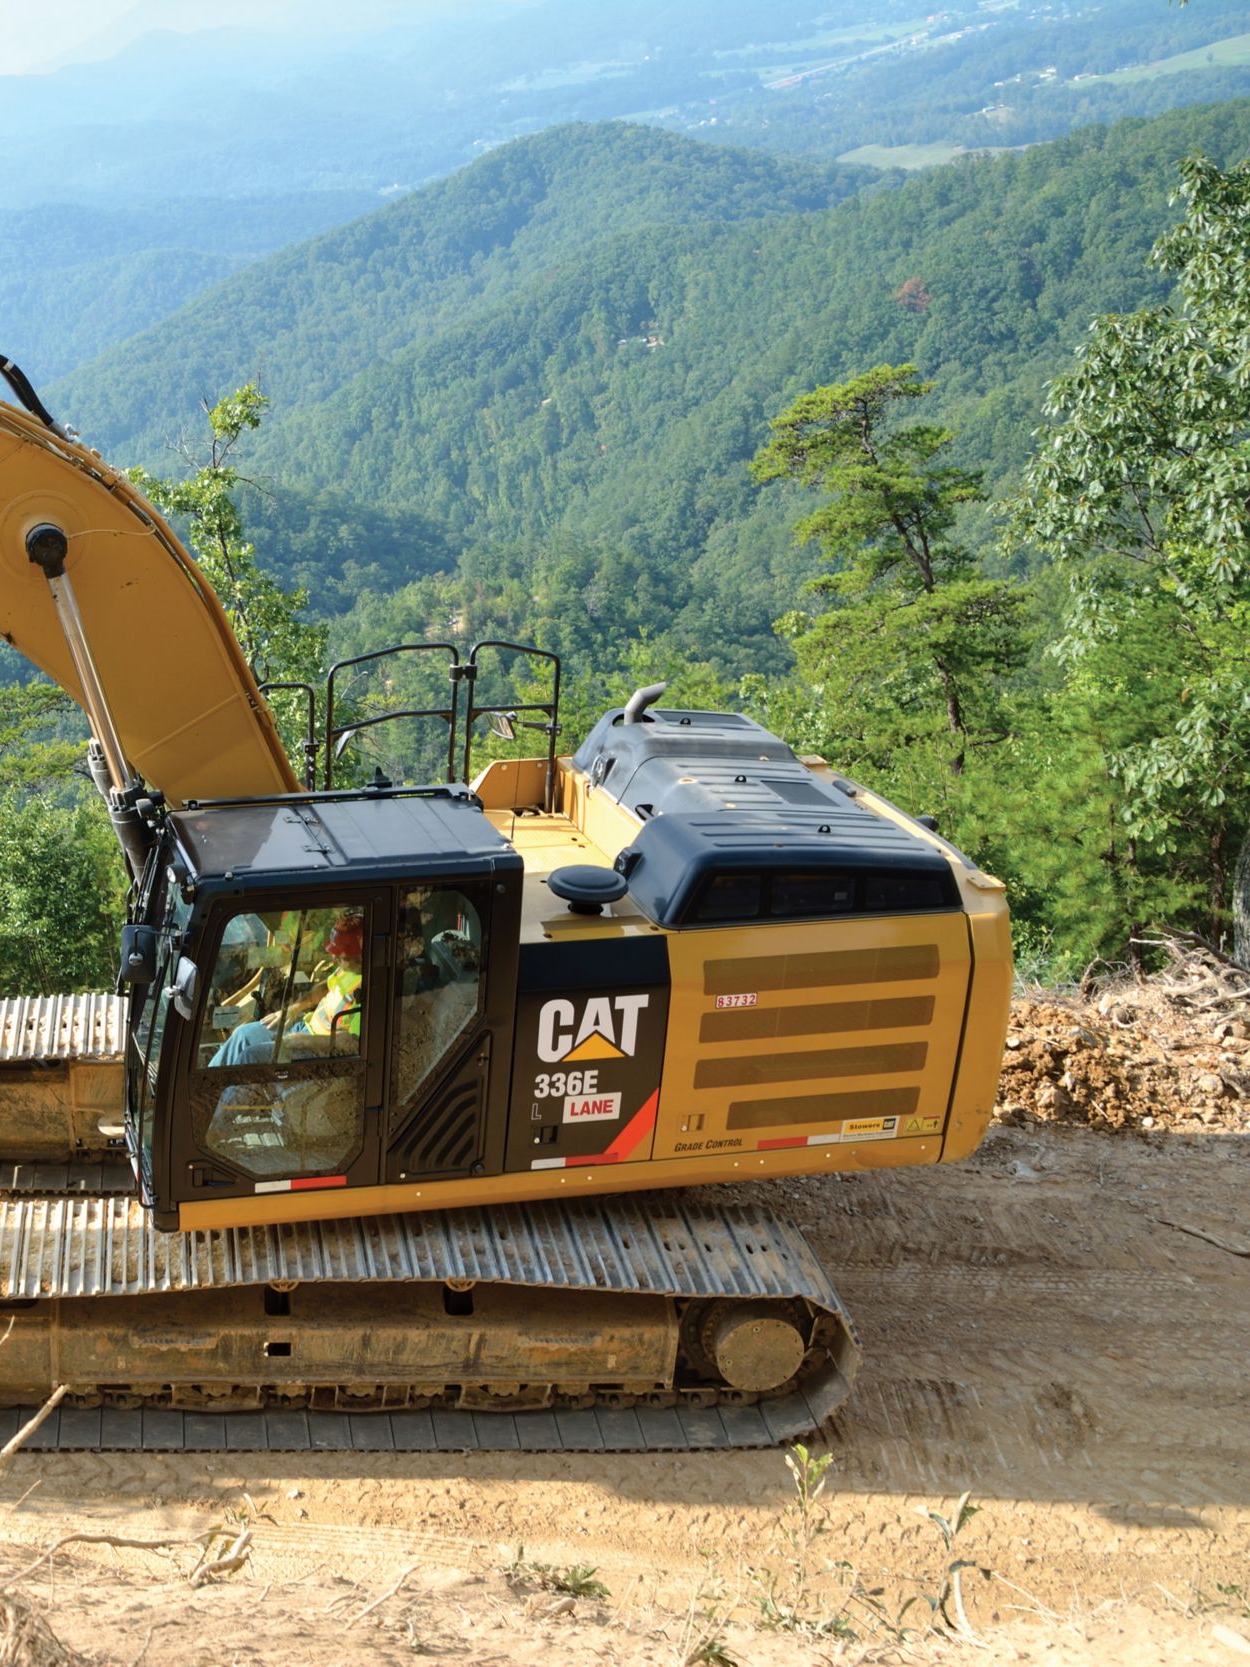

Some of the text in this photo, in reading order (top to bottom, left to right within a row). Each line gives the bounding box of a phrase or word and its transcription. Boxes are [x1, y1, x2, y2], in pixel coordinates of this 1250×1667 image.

[717, 995, 756, 1007] 83732
[537, 994, 649, 1063] CAT
[534, 1070, 599, 1098] 336E
[570, 1099, 614, 1116] LANE
[849, 1122, 880, 1130] Stowers
